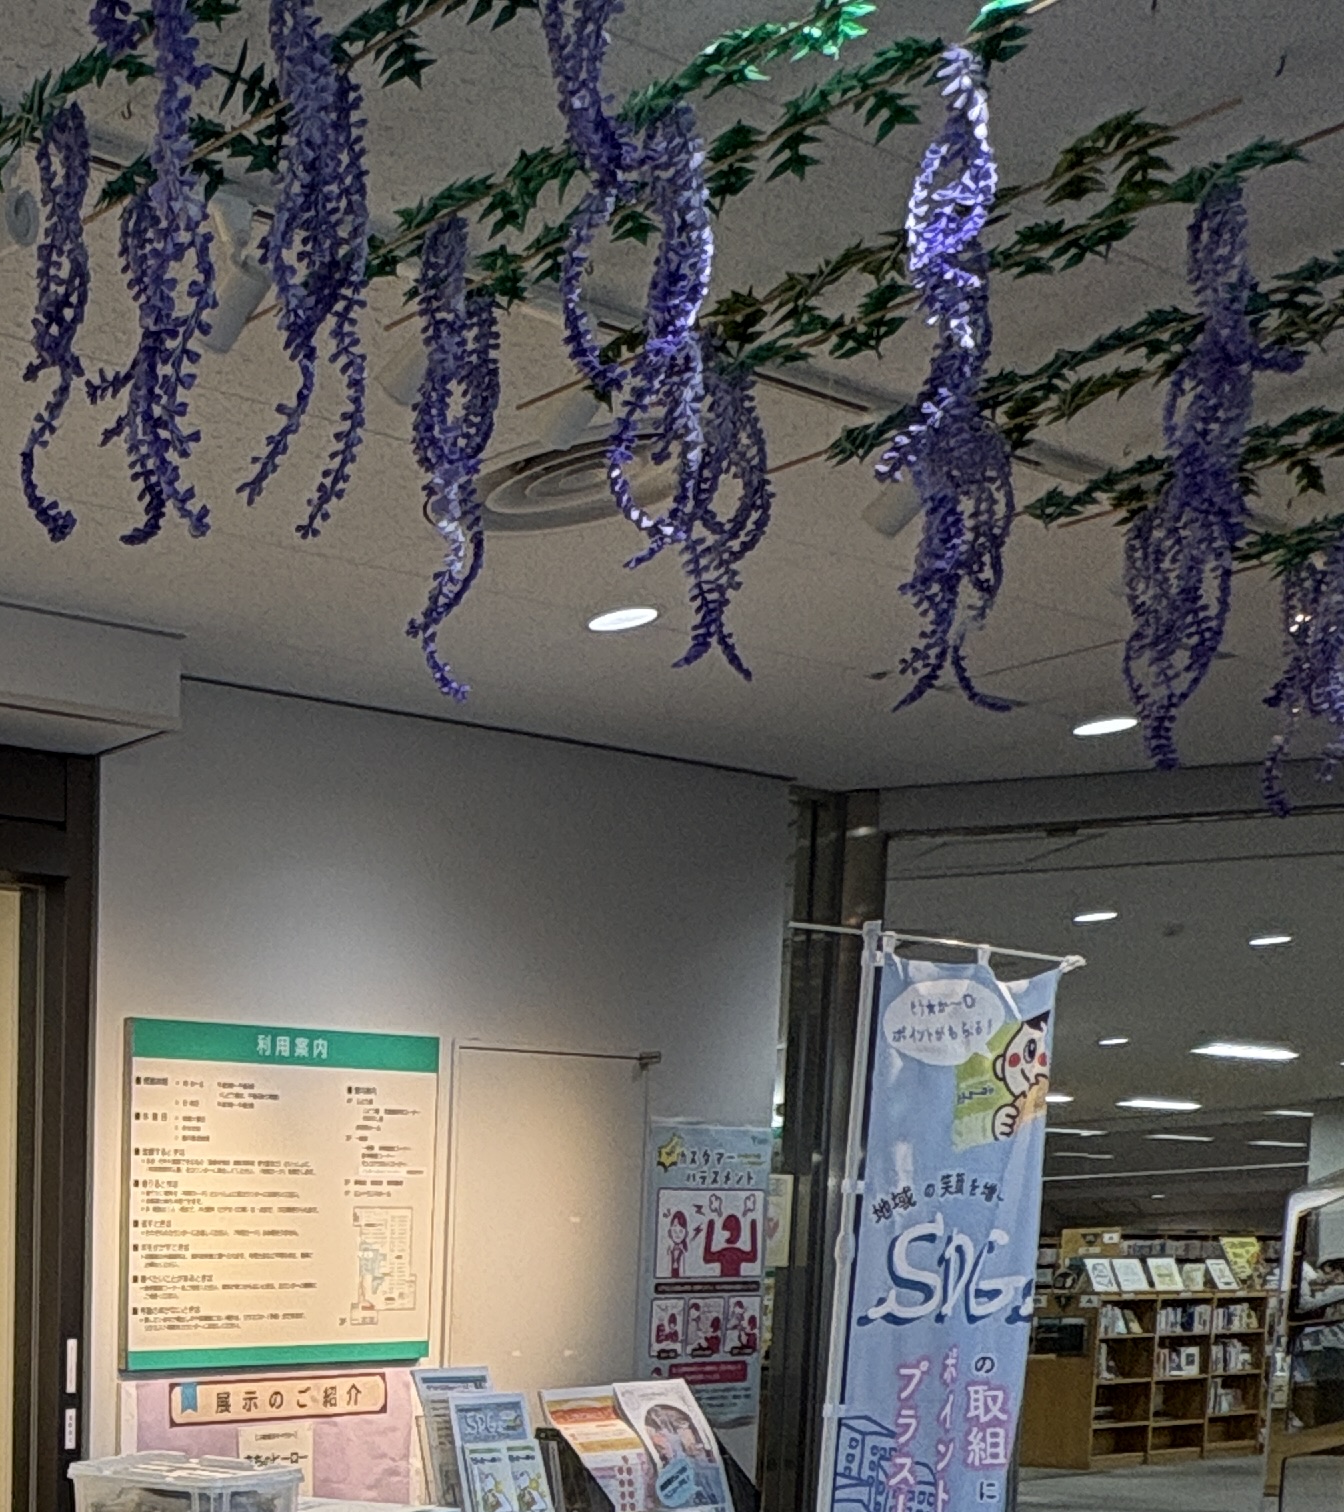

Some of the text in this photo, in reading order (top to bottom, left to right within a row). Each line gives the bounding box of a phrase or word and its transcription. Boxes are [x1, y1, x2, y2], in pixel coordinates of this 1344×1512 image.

[256, 1034, 329, 1059] 利用案内
[214, 1382, 363, 1414] 展示のご紹介
